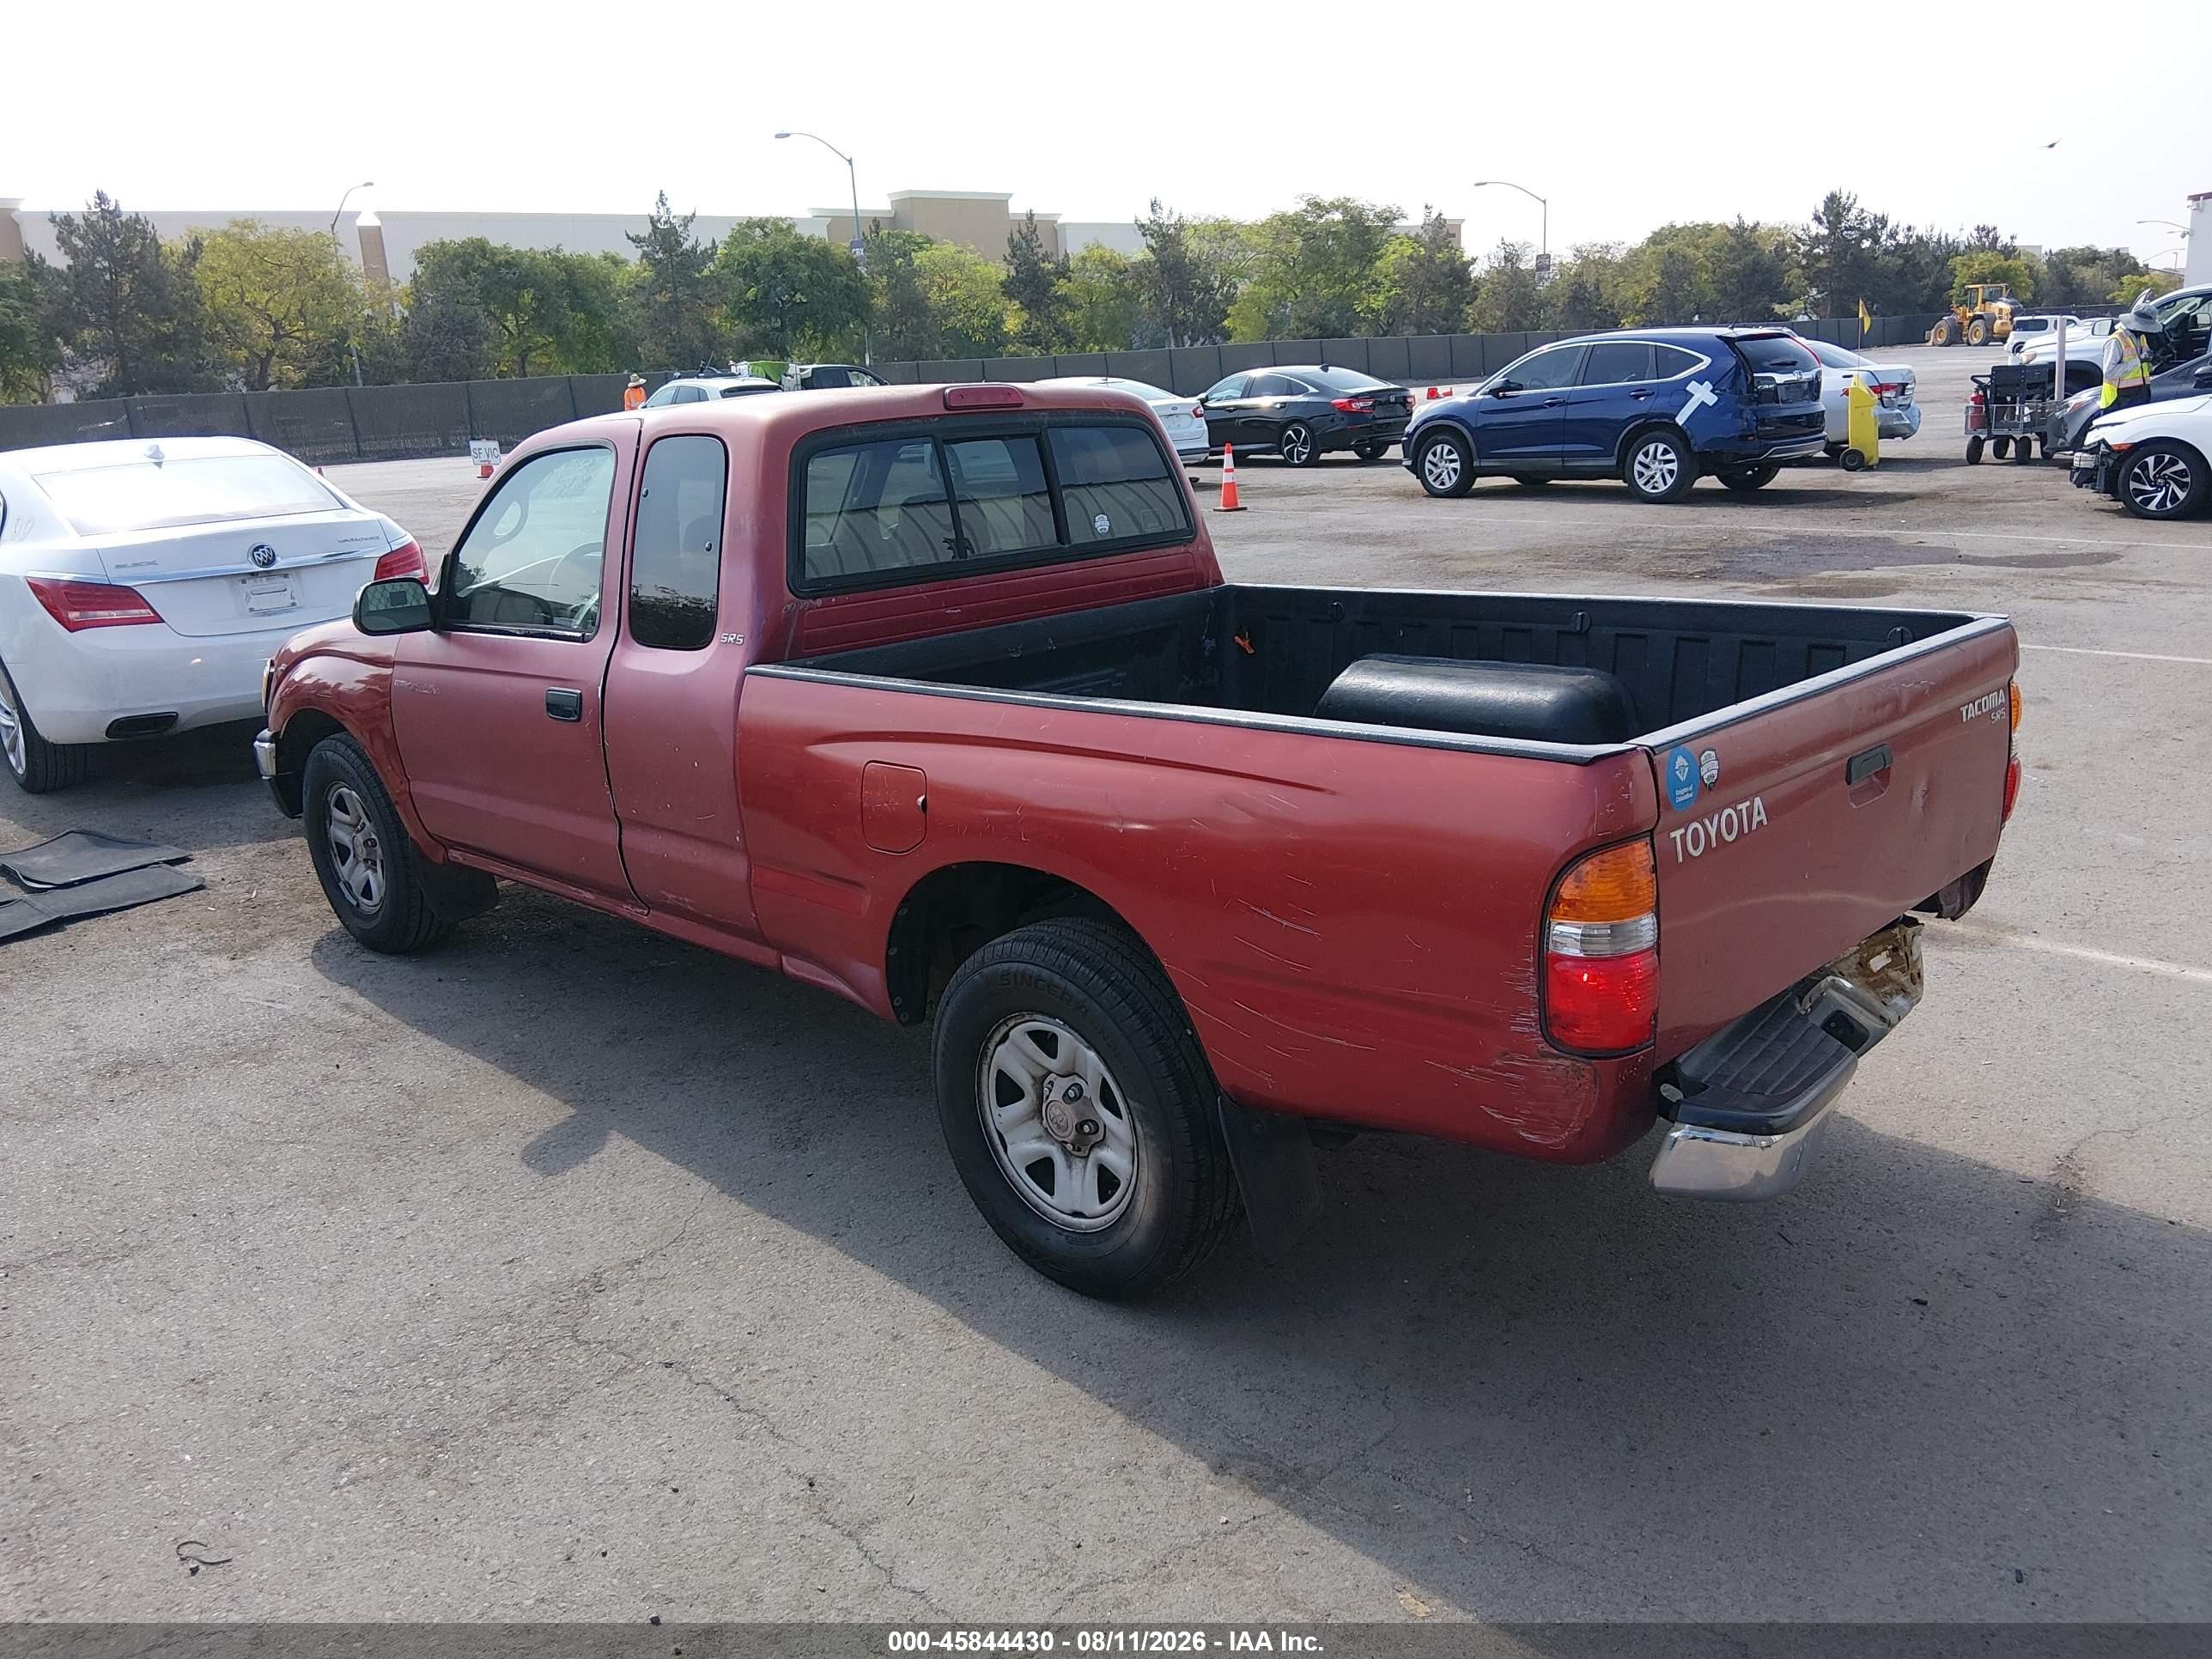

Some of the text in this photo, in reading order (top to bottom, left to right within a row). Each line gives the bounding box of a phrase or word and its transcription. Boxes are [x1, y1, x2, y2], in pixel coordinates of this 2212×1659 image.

[472, 447, 499, 459] SF VIC
[1960, 688, 2006, 723] TACOMA
[1669, 796, 1768, 864] TOYOTA
